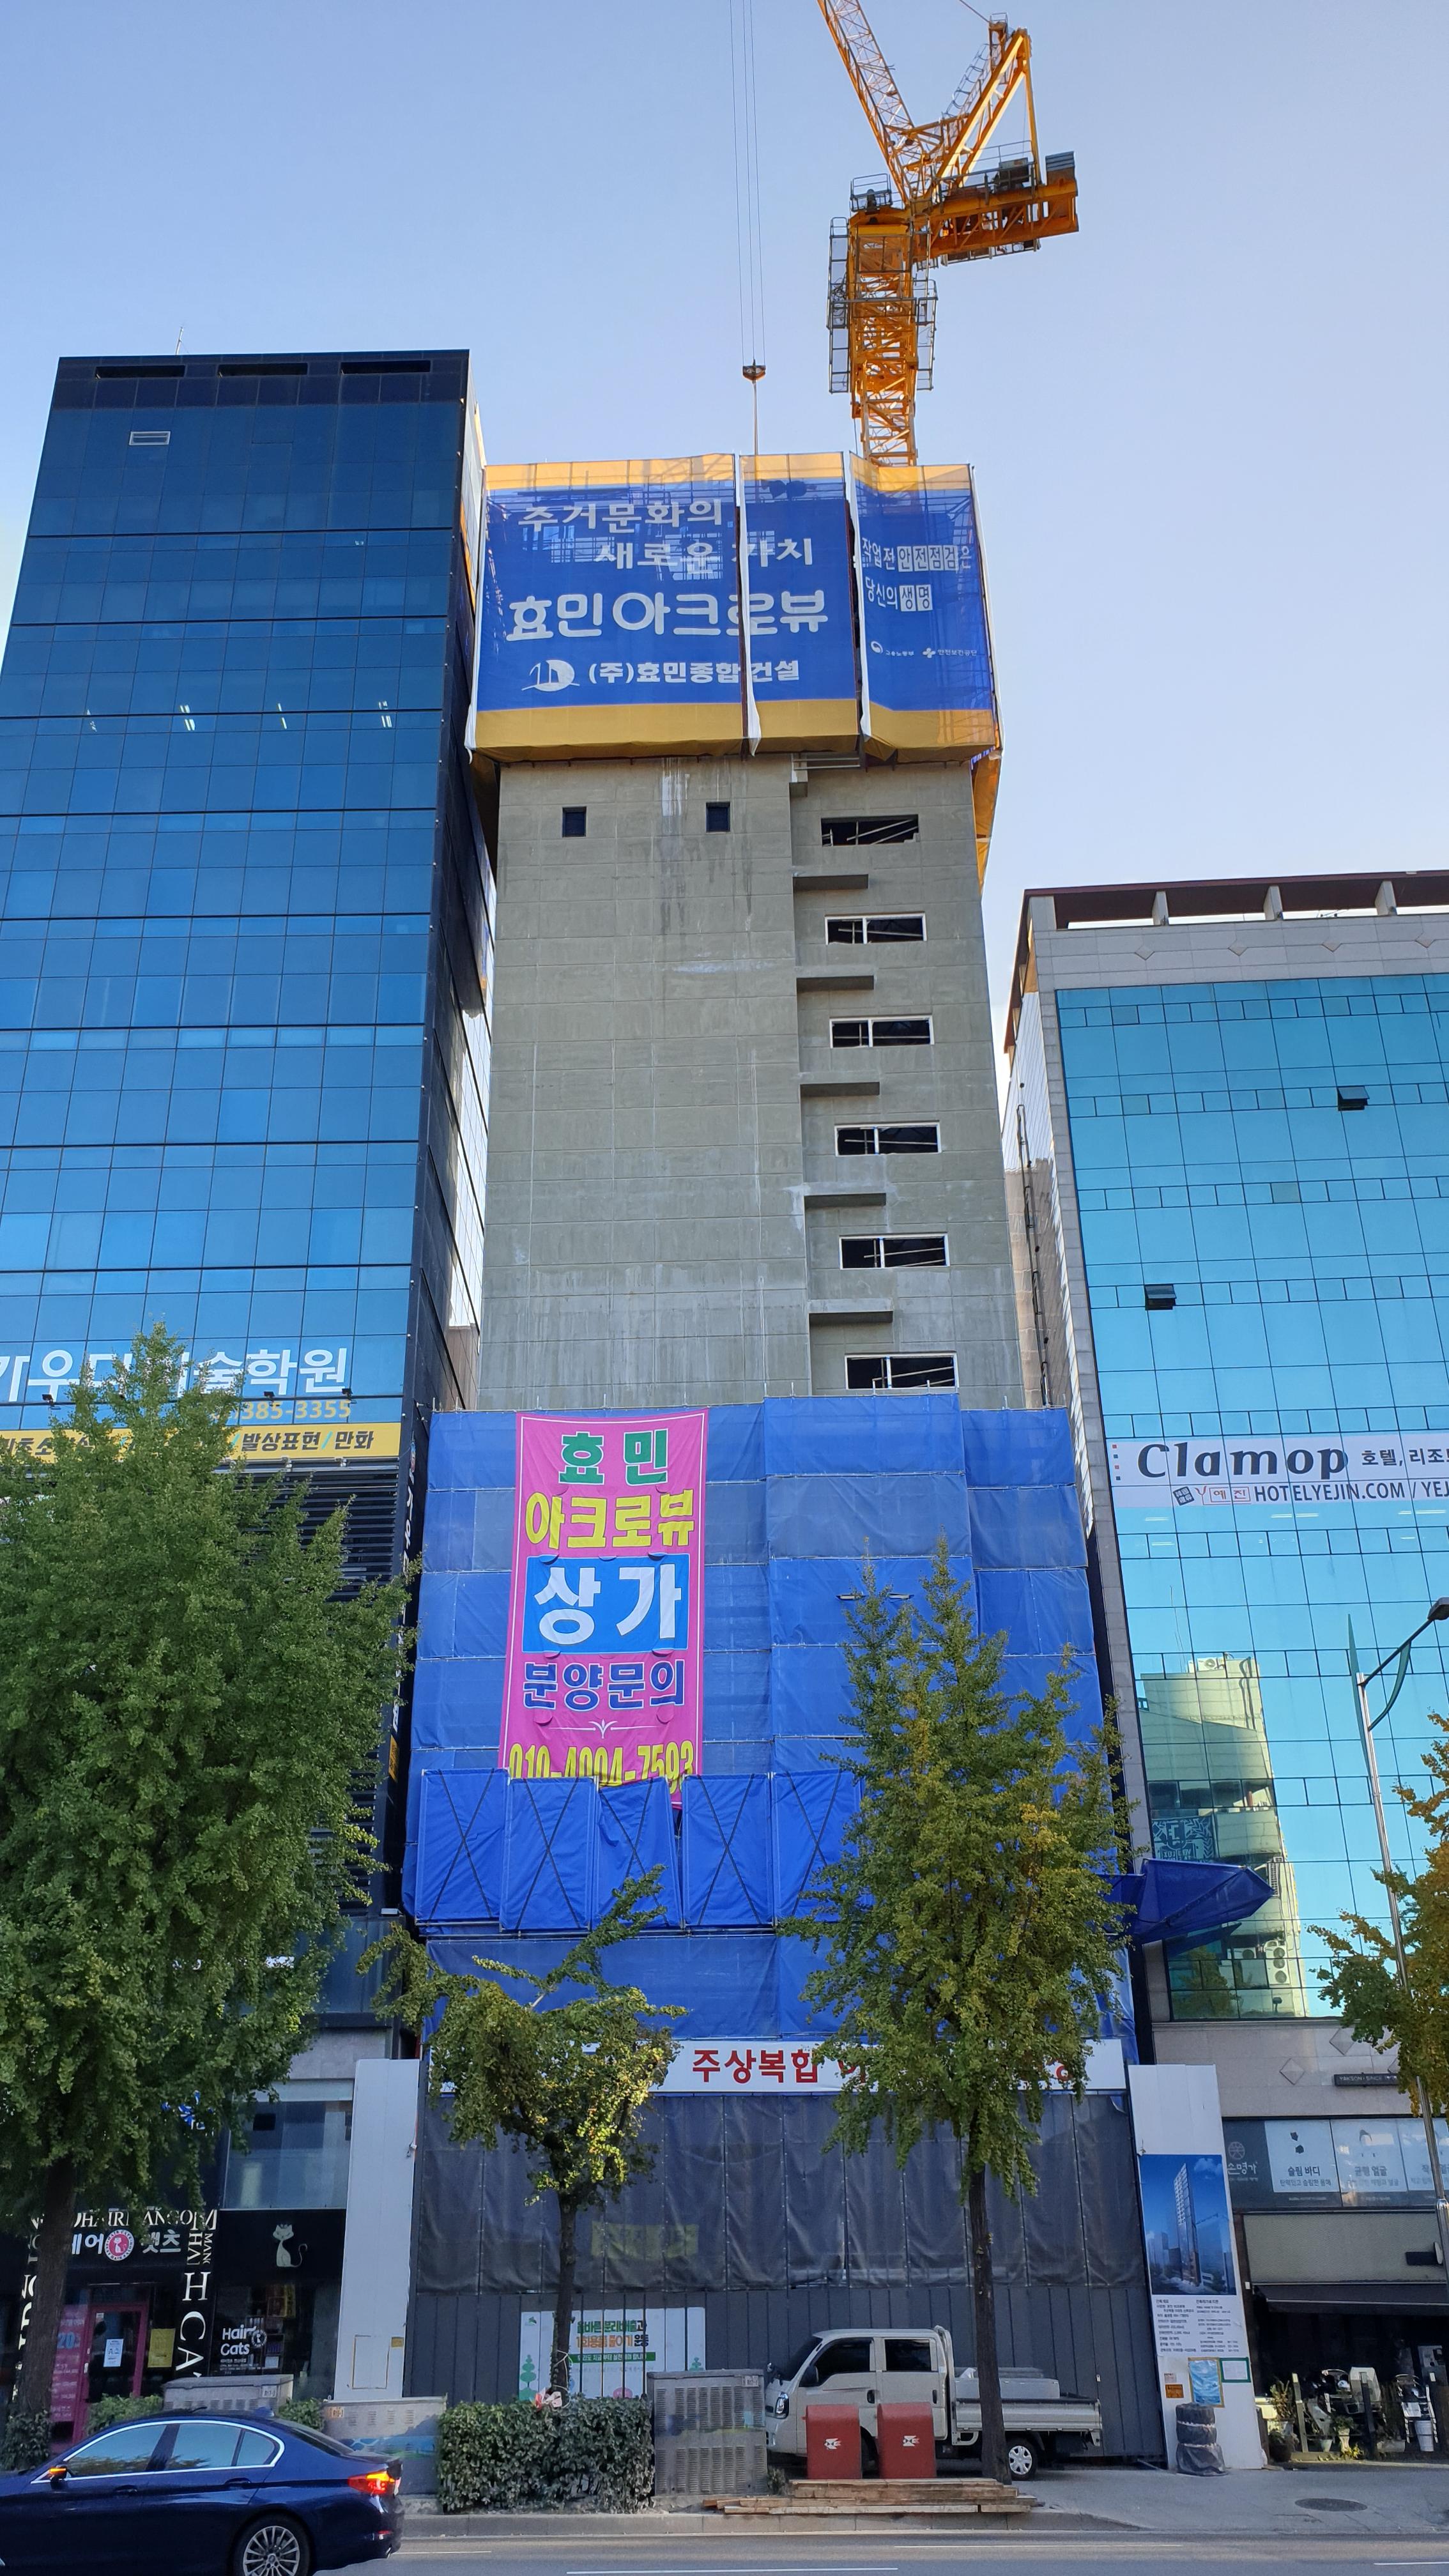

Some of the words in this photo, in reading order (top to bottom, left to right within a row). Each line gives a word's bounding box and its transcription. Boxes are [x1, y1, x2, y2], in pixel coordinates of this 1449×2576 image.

[518, 498, 722, 534] 주거문화의
[594, 542, 721, 573] 새로운
[900, 585, 933, 611] 생명
[588, 660, 799, 685] (주)효민종합건설
[558, 1428, 670, 1487] 효민
[1137, 1441, 1349, 1480] Clamop
[1361, 1448, 1403, 1467] 호텔,
[1408, 1447, 1449, 1466] 리조
[1254, 1482, 1406, 1502] HOTELYEJIN.COM
[525, 1488, 694, 1550] 아크로뷰
[533, 1563, 682, 1645] 상가
[522, 1659, 686, 1712] 분양문의
[693, 2048, 819, 2084] 주상복합
[1304, 2165, 1321, 2177] 바디
[222, 2324, 257, 2340] Hair
[220, 2342, 250, 2356] Cats
